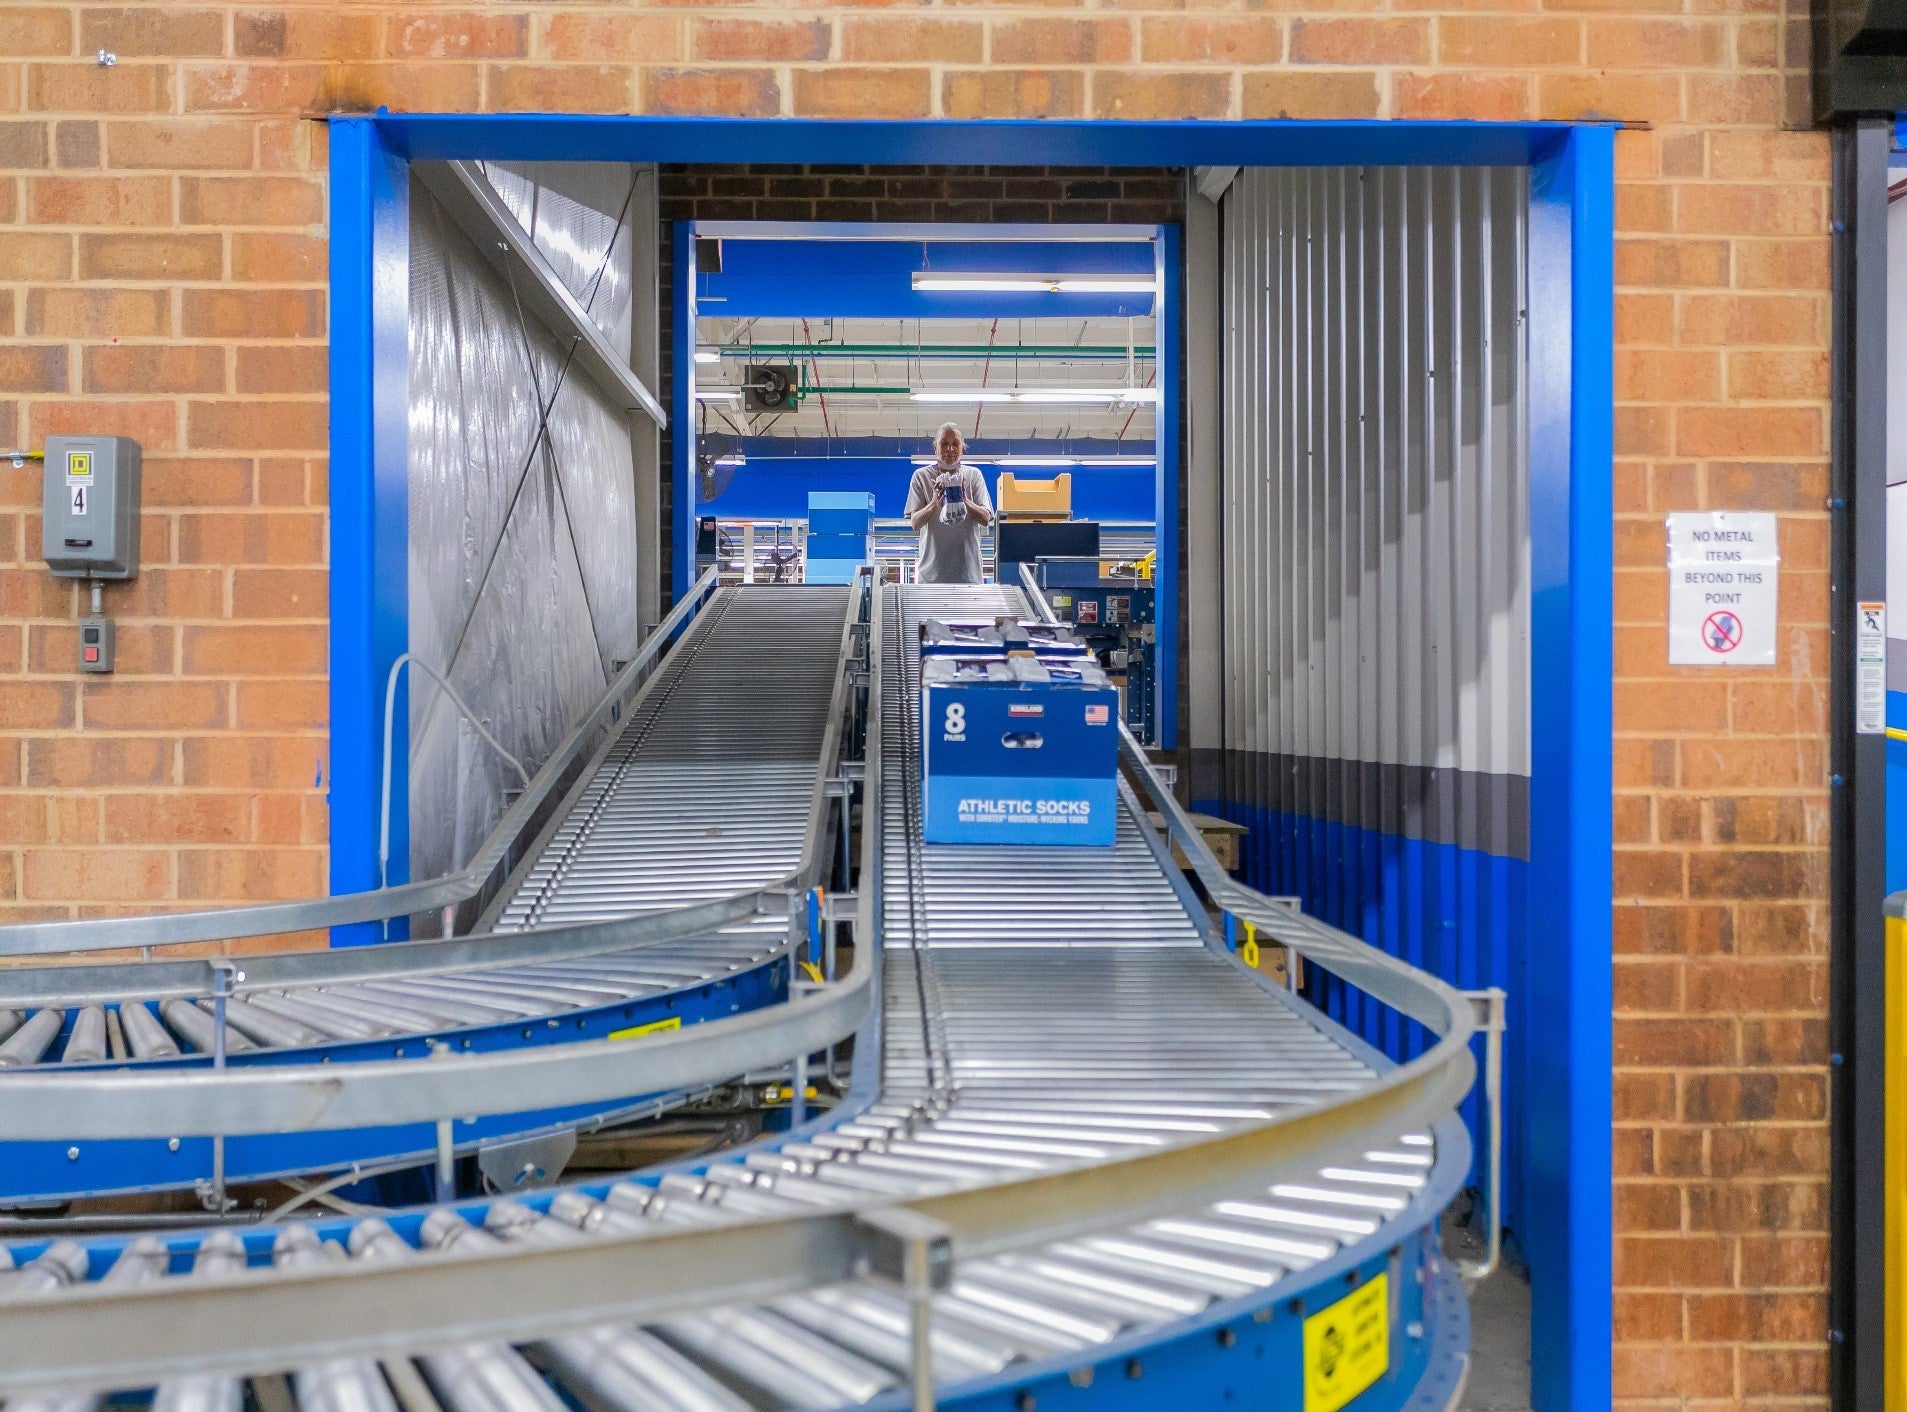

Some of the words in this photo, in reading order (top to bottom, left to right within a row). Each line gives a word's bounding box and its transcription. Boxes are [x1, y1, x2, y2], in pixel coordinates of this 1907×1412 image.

[74, 488, 84, 513] 4
[1692, 531, 1711, 542] NO
[1714, 531, 1754, 542] METAL
[1705, 551, 1742, 562] ITEMS
[1685, 573, 1733, 584] BEYOND
[1737, 573, 1762, 584] THIS
[1705, 593, 1741, 604] POINT
[945, 702, 966, 734] 8
[944, 733, 967, 742] PAIRS
[958, 799, 1032, 814] ATHLETIC
[1036, 800, 1091, 815] SOCKS
